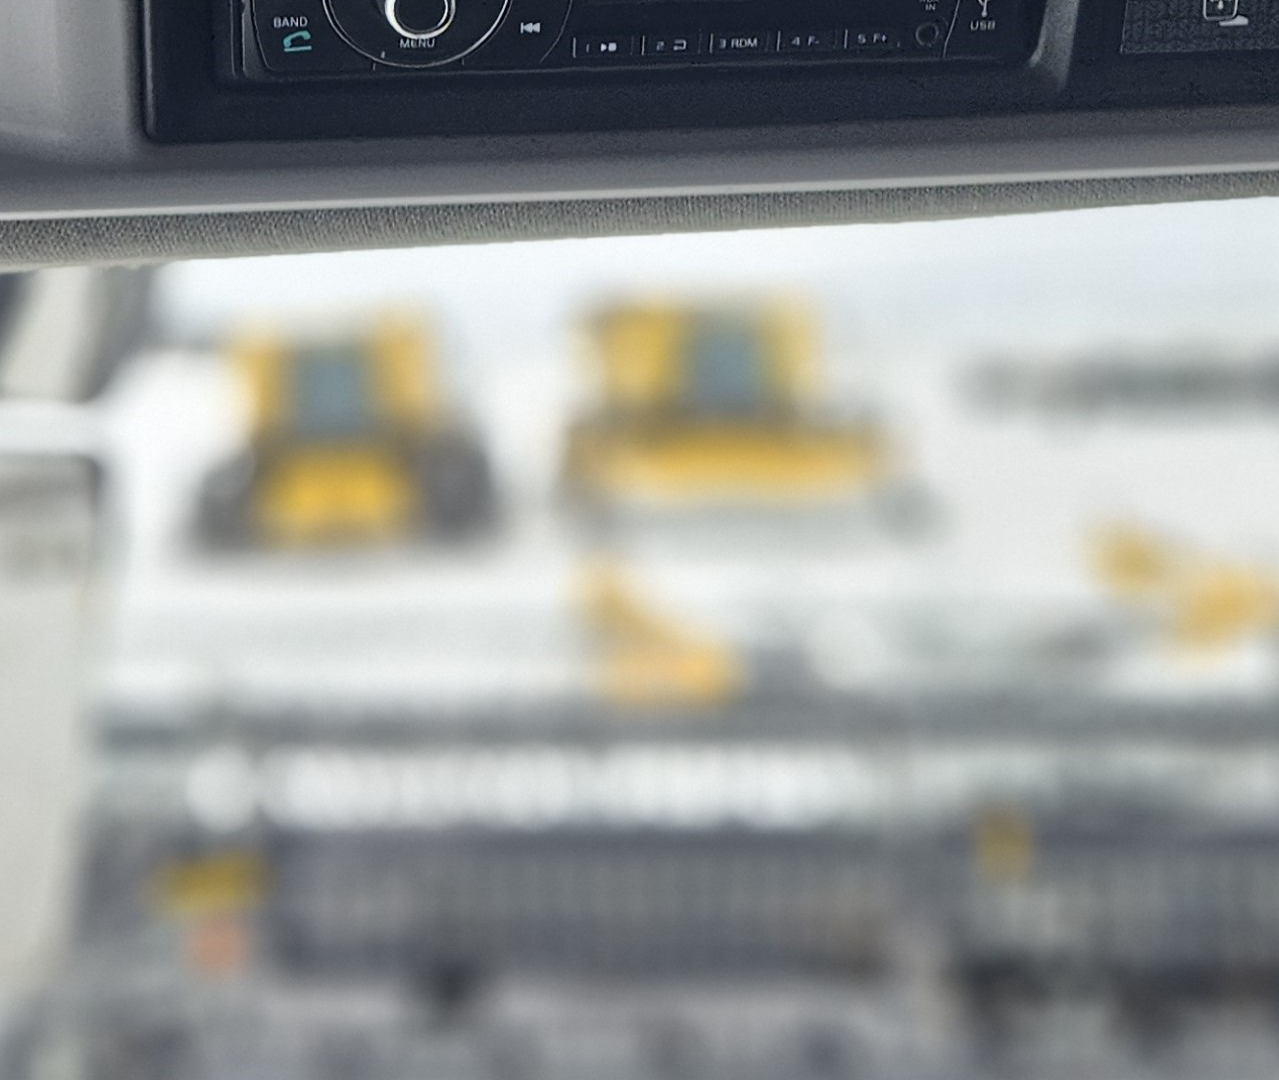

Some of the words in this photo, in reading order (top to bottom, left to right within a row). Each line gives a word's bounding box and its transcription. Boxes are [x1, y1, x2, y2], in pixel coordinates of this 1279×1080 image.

[925, 3, 937, 12] IN
[273, 16, 309, 29] BAND
[969, 20, 996, 32] USB
[399, 37, 436, 49] MENU
[730, 37, 759, 49] RDM
